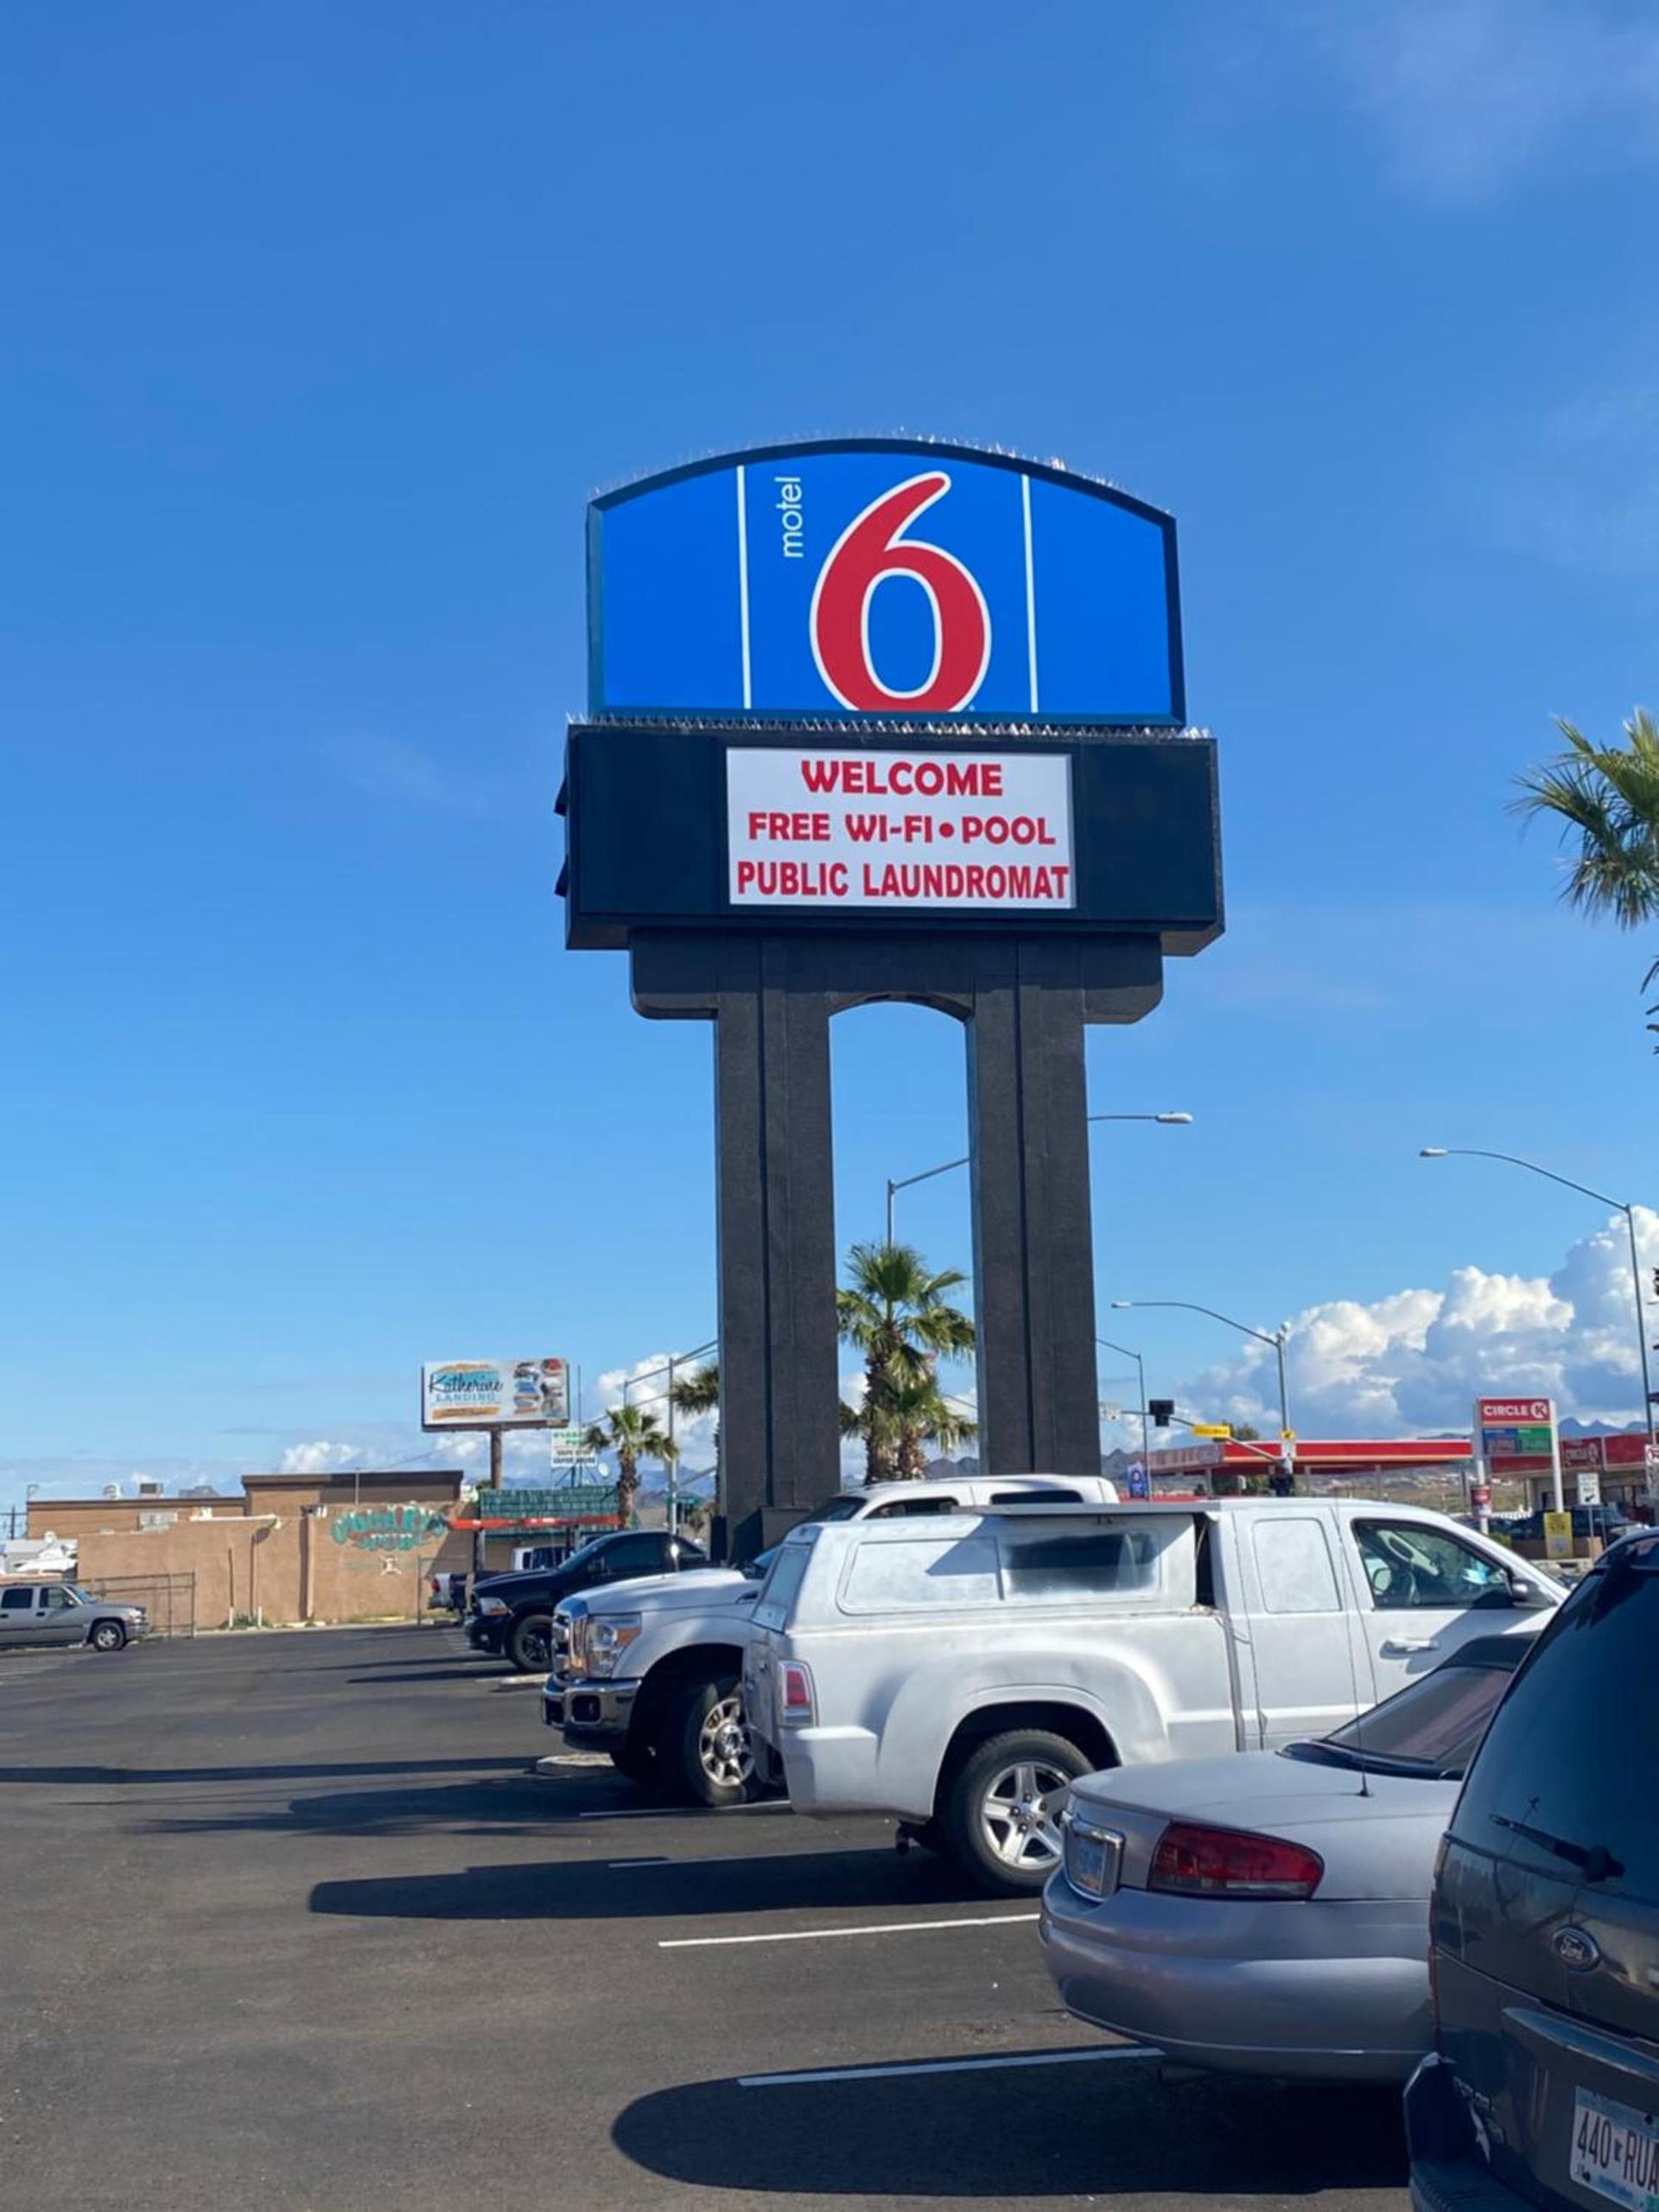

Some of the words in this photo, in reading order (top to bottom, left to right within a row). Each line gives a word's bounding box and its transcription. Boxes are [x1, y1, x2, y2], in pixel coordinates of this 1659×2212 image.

[774, 476, 804, 558] motel
[810, 471, 992, 712] 6
[801, 760, 1003, 797] WELCOME
[748, 811, 831, 842] FREE
[738, 861, 849, 897] PUBLIC
[862, 863, 1069, 899] LAUNDROMAT
[1484, 1404, 1529, 1416] CIRCLE
[1530, 1401, 1548, 1419] K
[1577, 2110, 1612, 2169] 440
